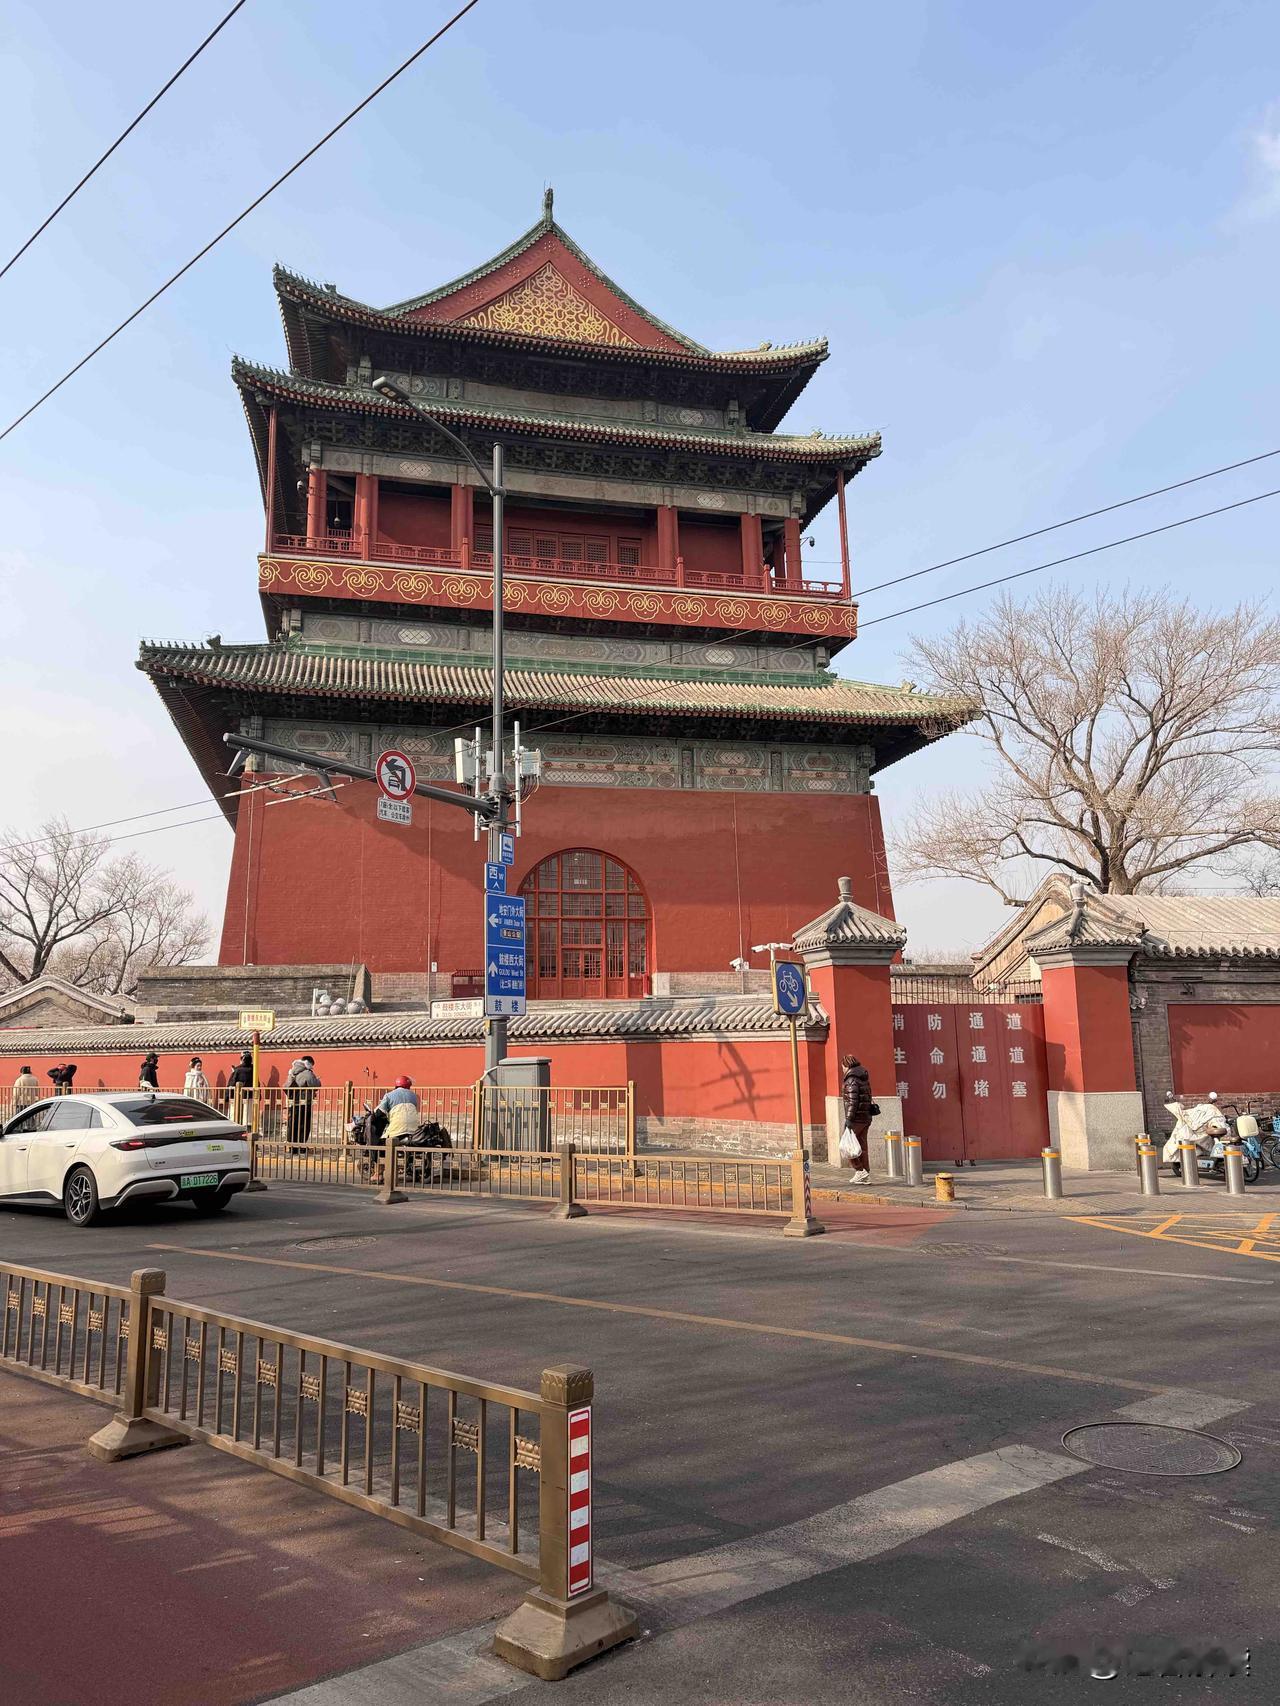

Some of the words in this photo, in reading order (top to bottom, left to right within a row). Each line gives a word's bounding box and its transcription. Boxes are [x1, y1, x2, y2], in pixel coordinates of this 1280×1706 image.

[489, 866, 498, 879] 西
[499, 953, 524, 966] 鼓楼西大街
[494, 999, 519, 1012] 鼓楼
[892, 1012, 1022, 1031] 消防通道
[894, 1046, 1025, 1065] 生命通道
[896, 1080, 1027, 1099] 请勿堵塞
